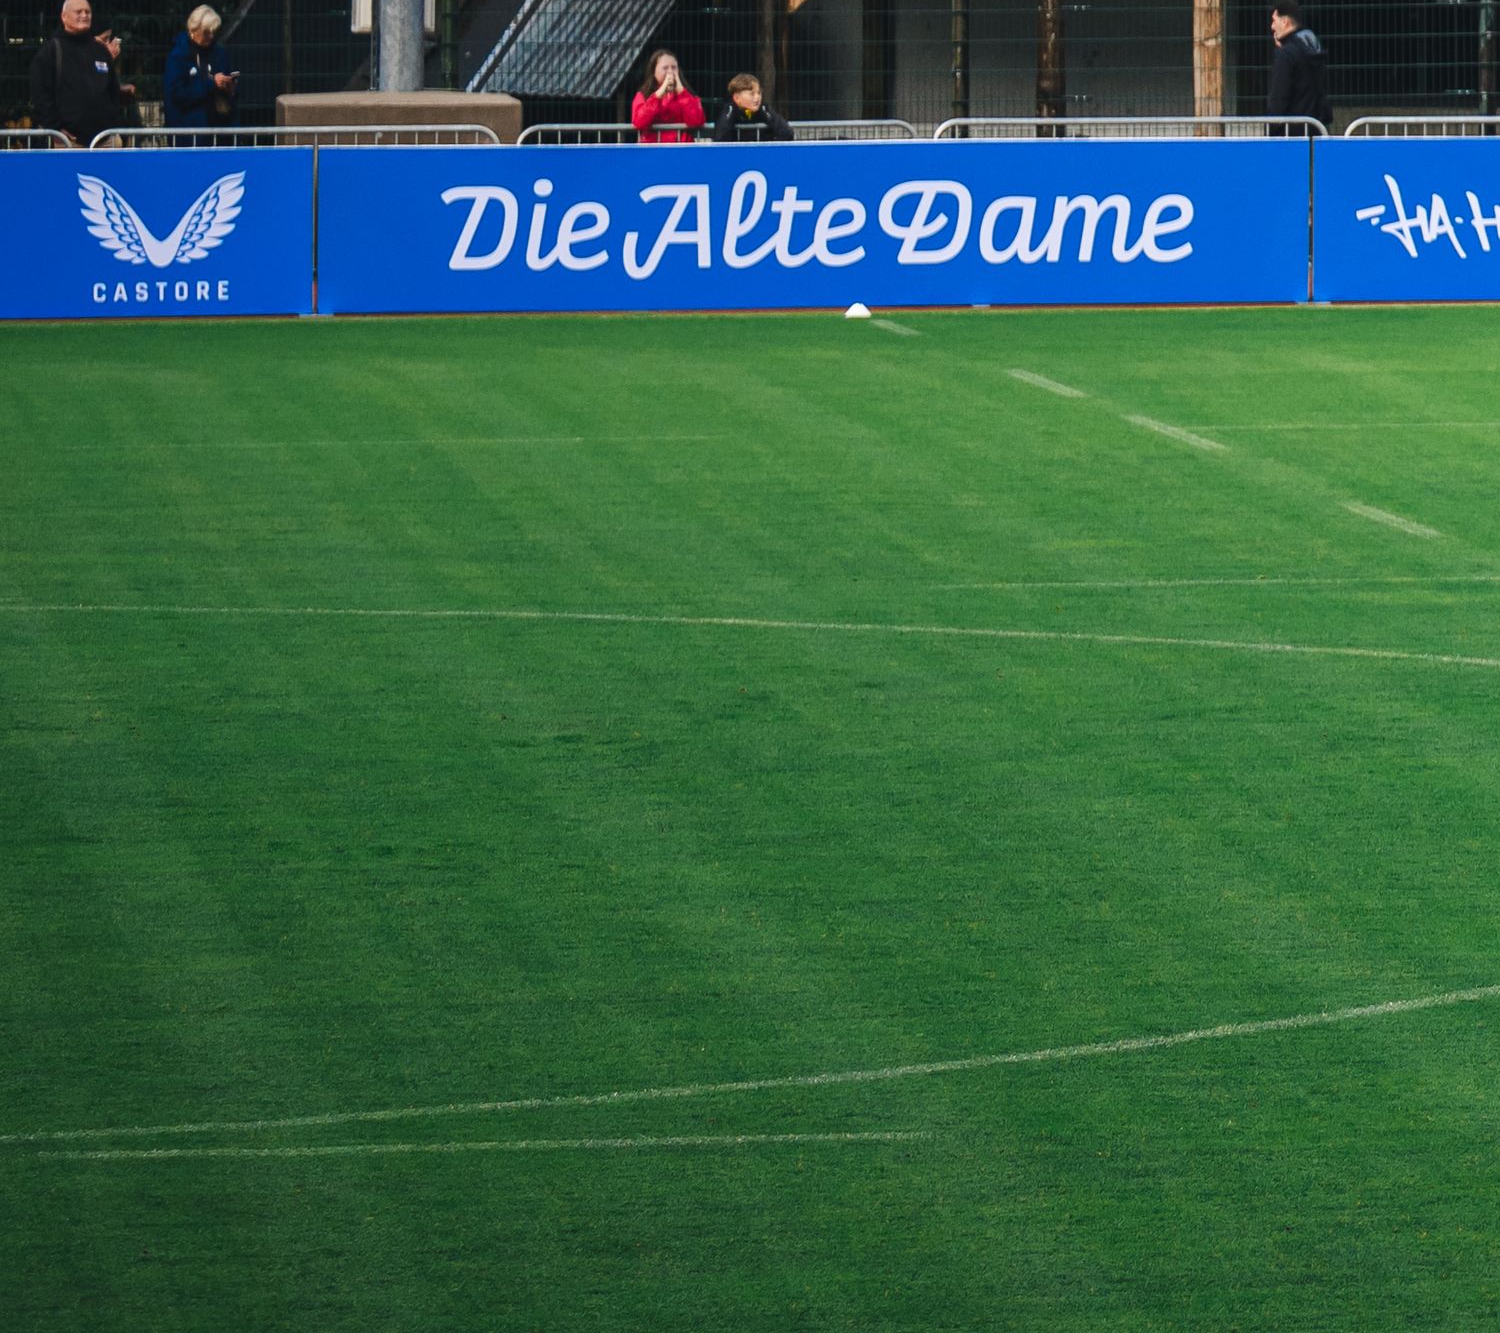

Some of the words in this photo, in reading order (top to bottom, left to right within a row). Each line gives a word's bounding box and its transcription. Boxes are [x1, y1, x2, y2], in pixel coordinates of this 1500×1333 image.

[441, 179, 610, 270] Die
[623, 170, 866, 279] Alte
[878, 180, 1194, 265] Dame
[92, 280, 231, 303] CASTORE
